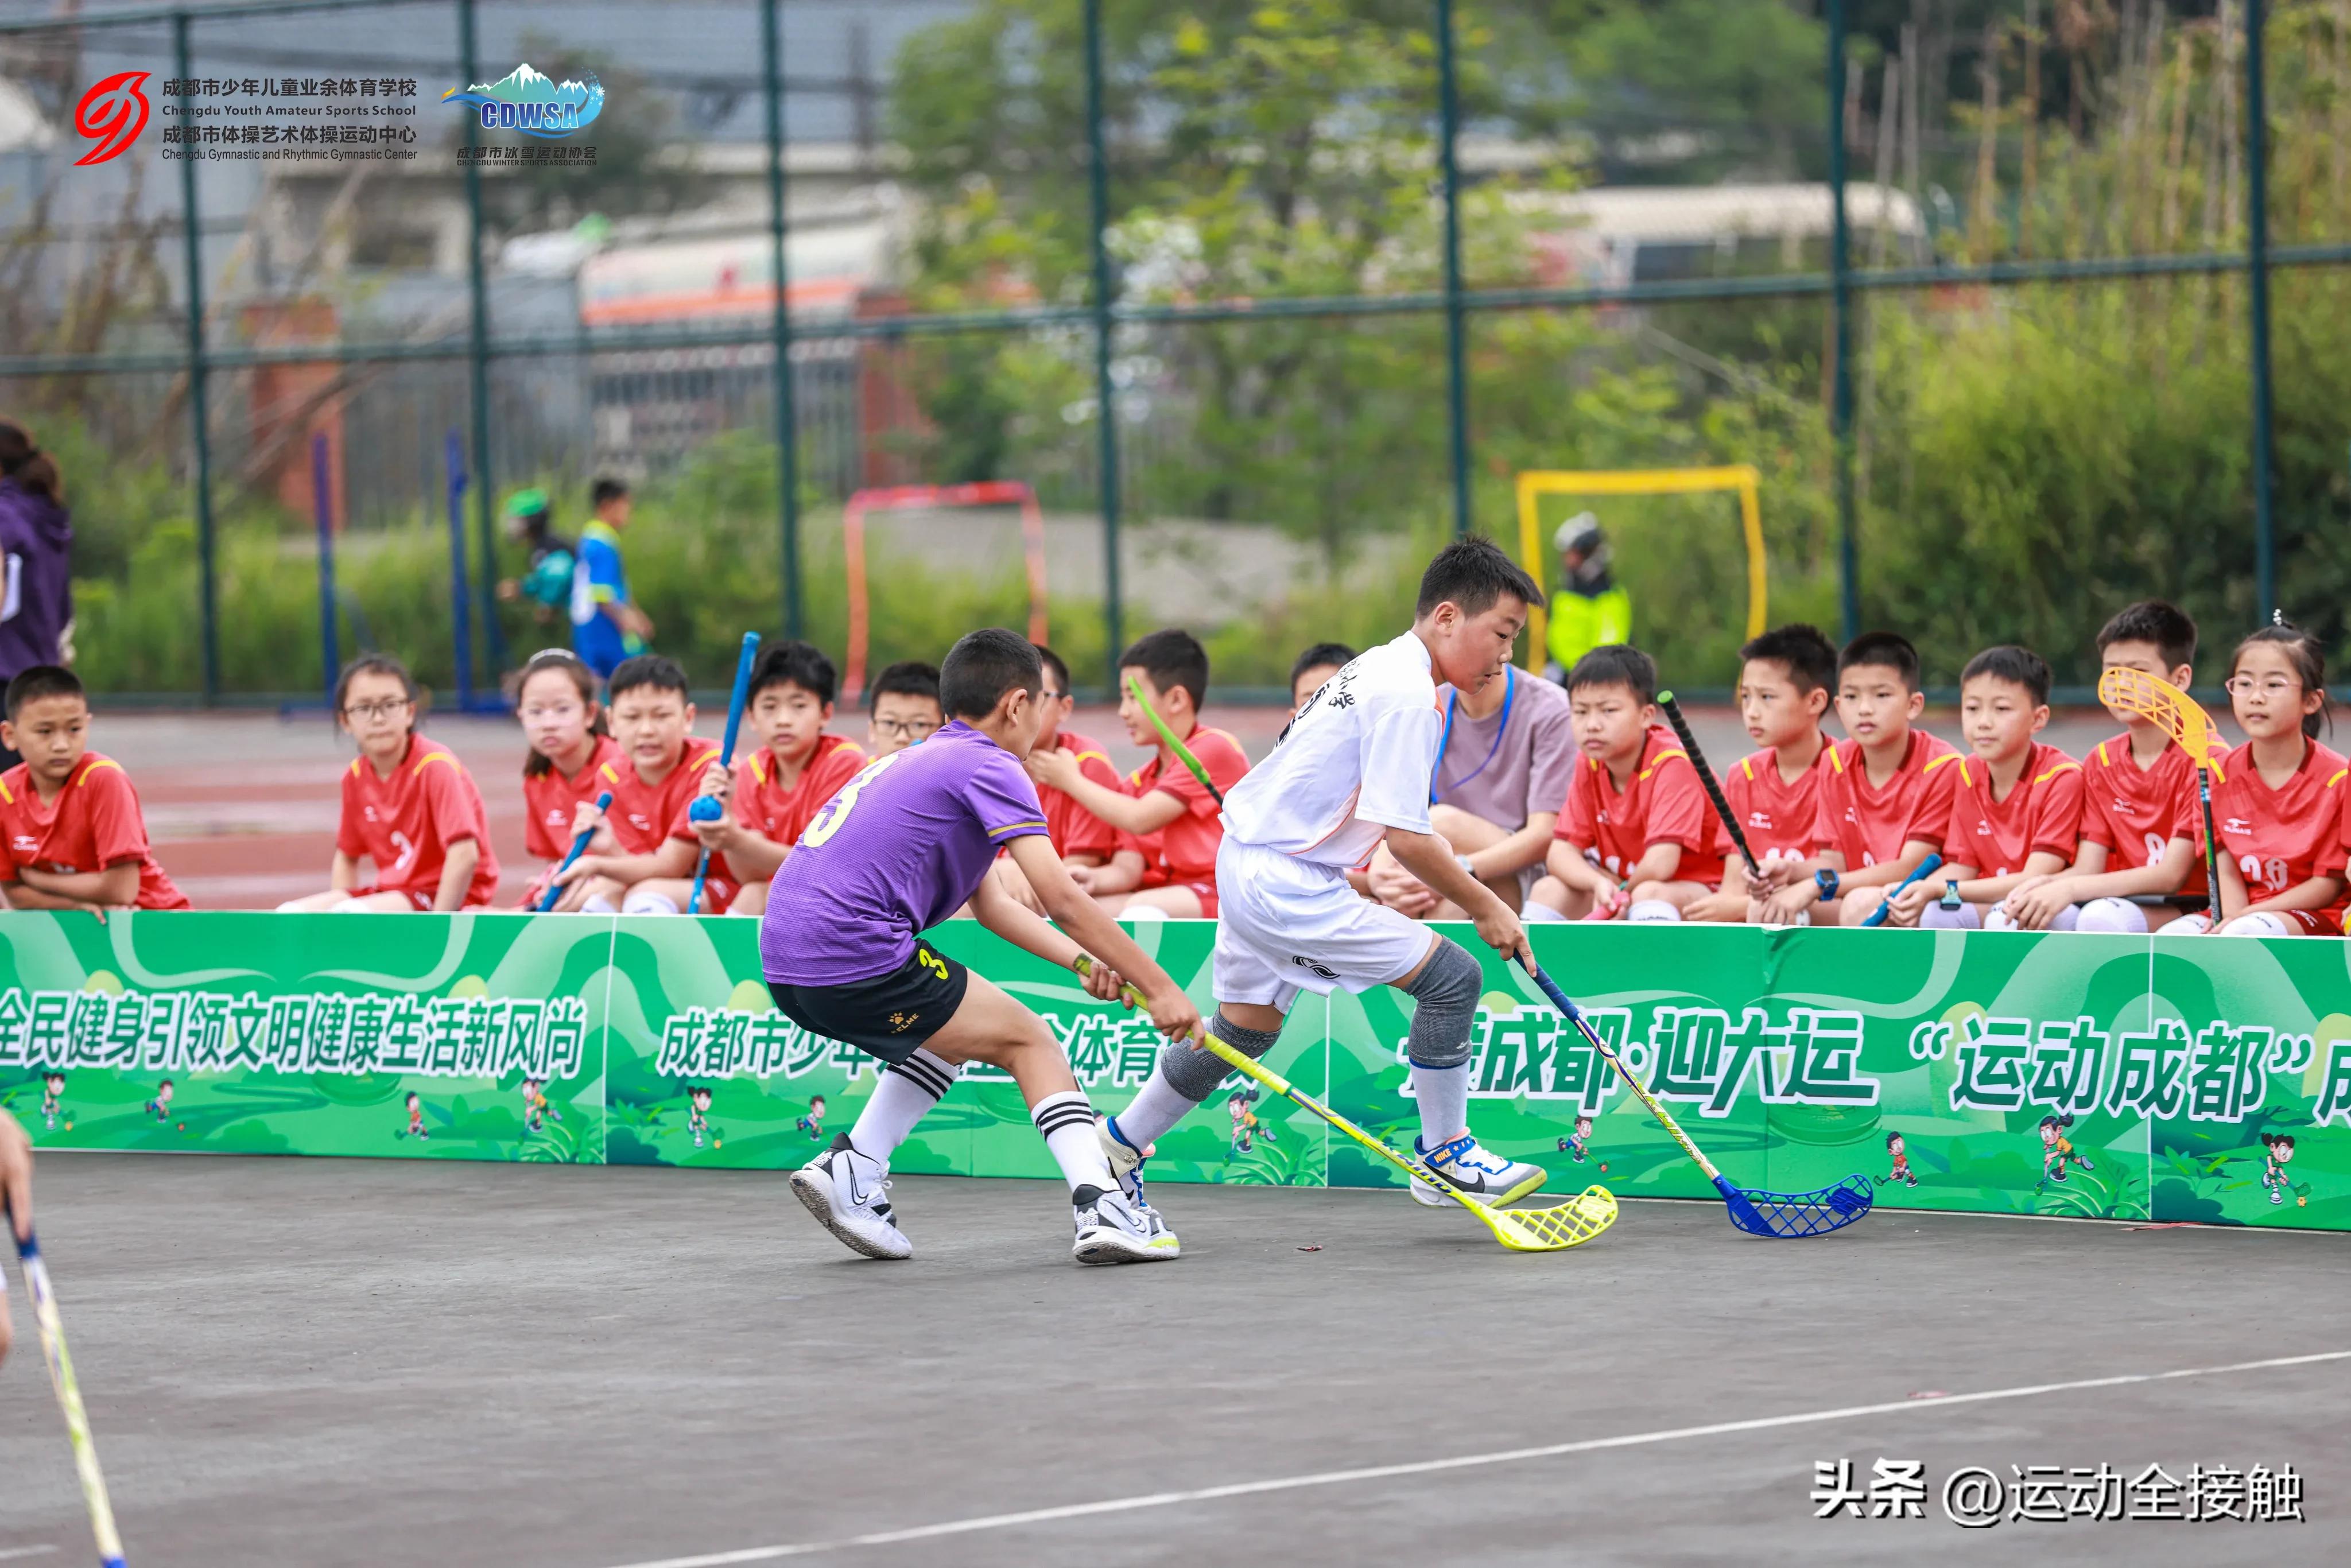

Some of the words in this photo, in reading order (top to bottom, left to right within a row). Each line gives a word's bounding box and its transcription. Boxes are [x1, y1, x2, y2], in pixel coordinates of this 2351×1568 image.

[803, 754, 899, 848] 3
[918, 948, 949, 980] 3
[0, 987, 587, 1080] 全民健身引领文明健康生活新风尚
[1433, 1148, 1452, 1163] NIKE
